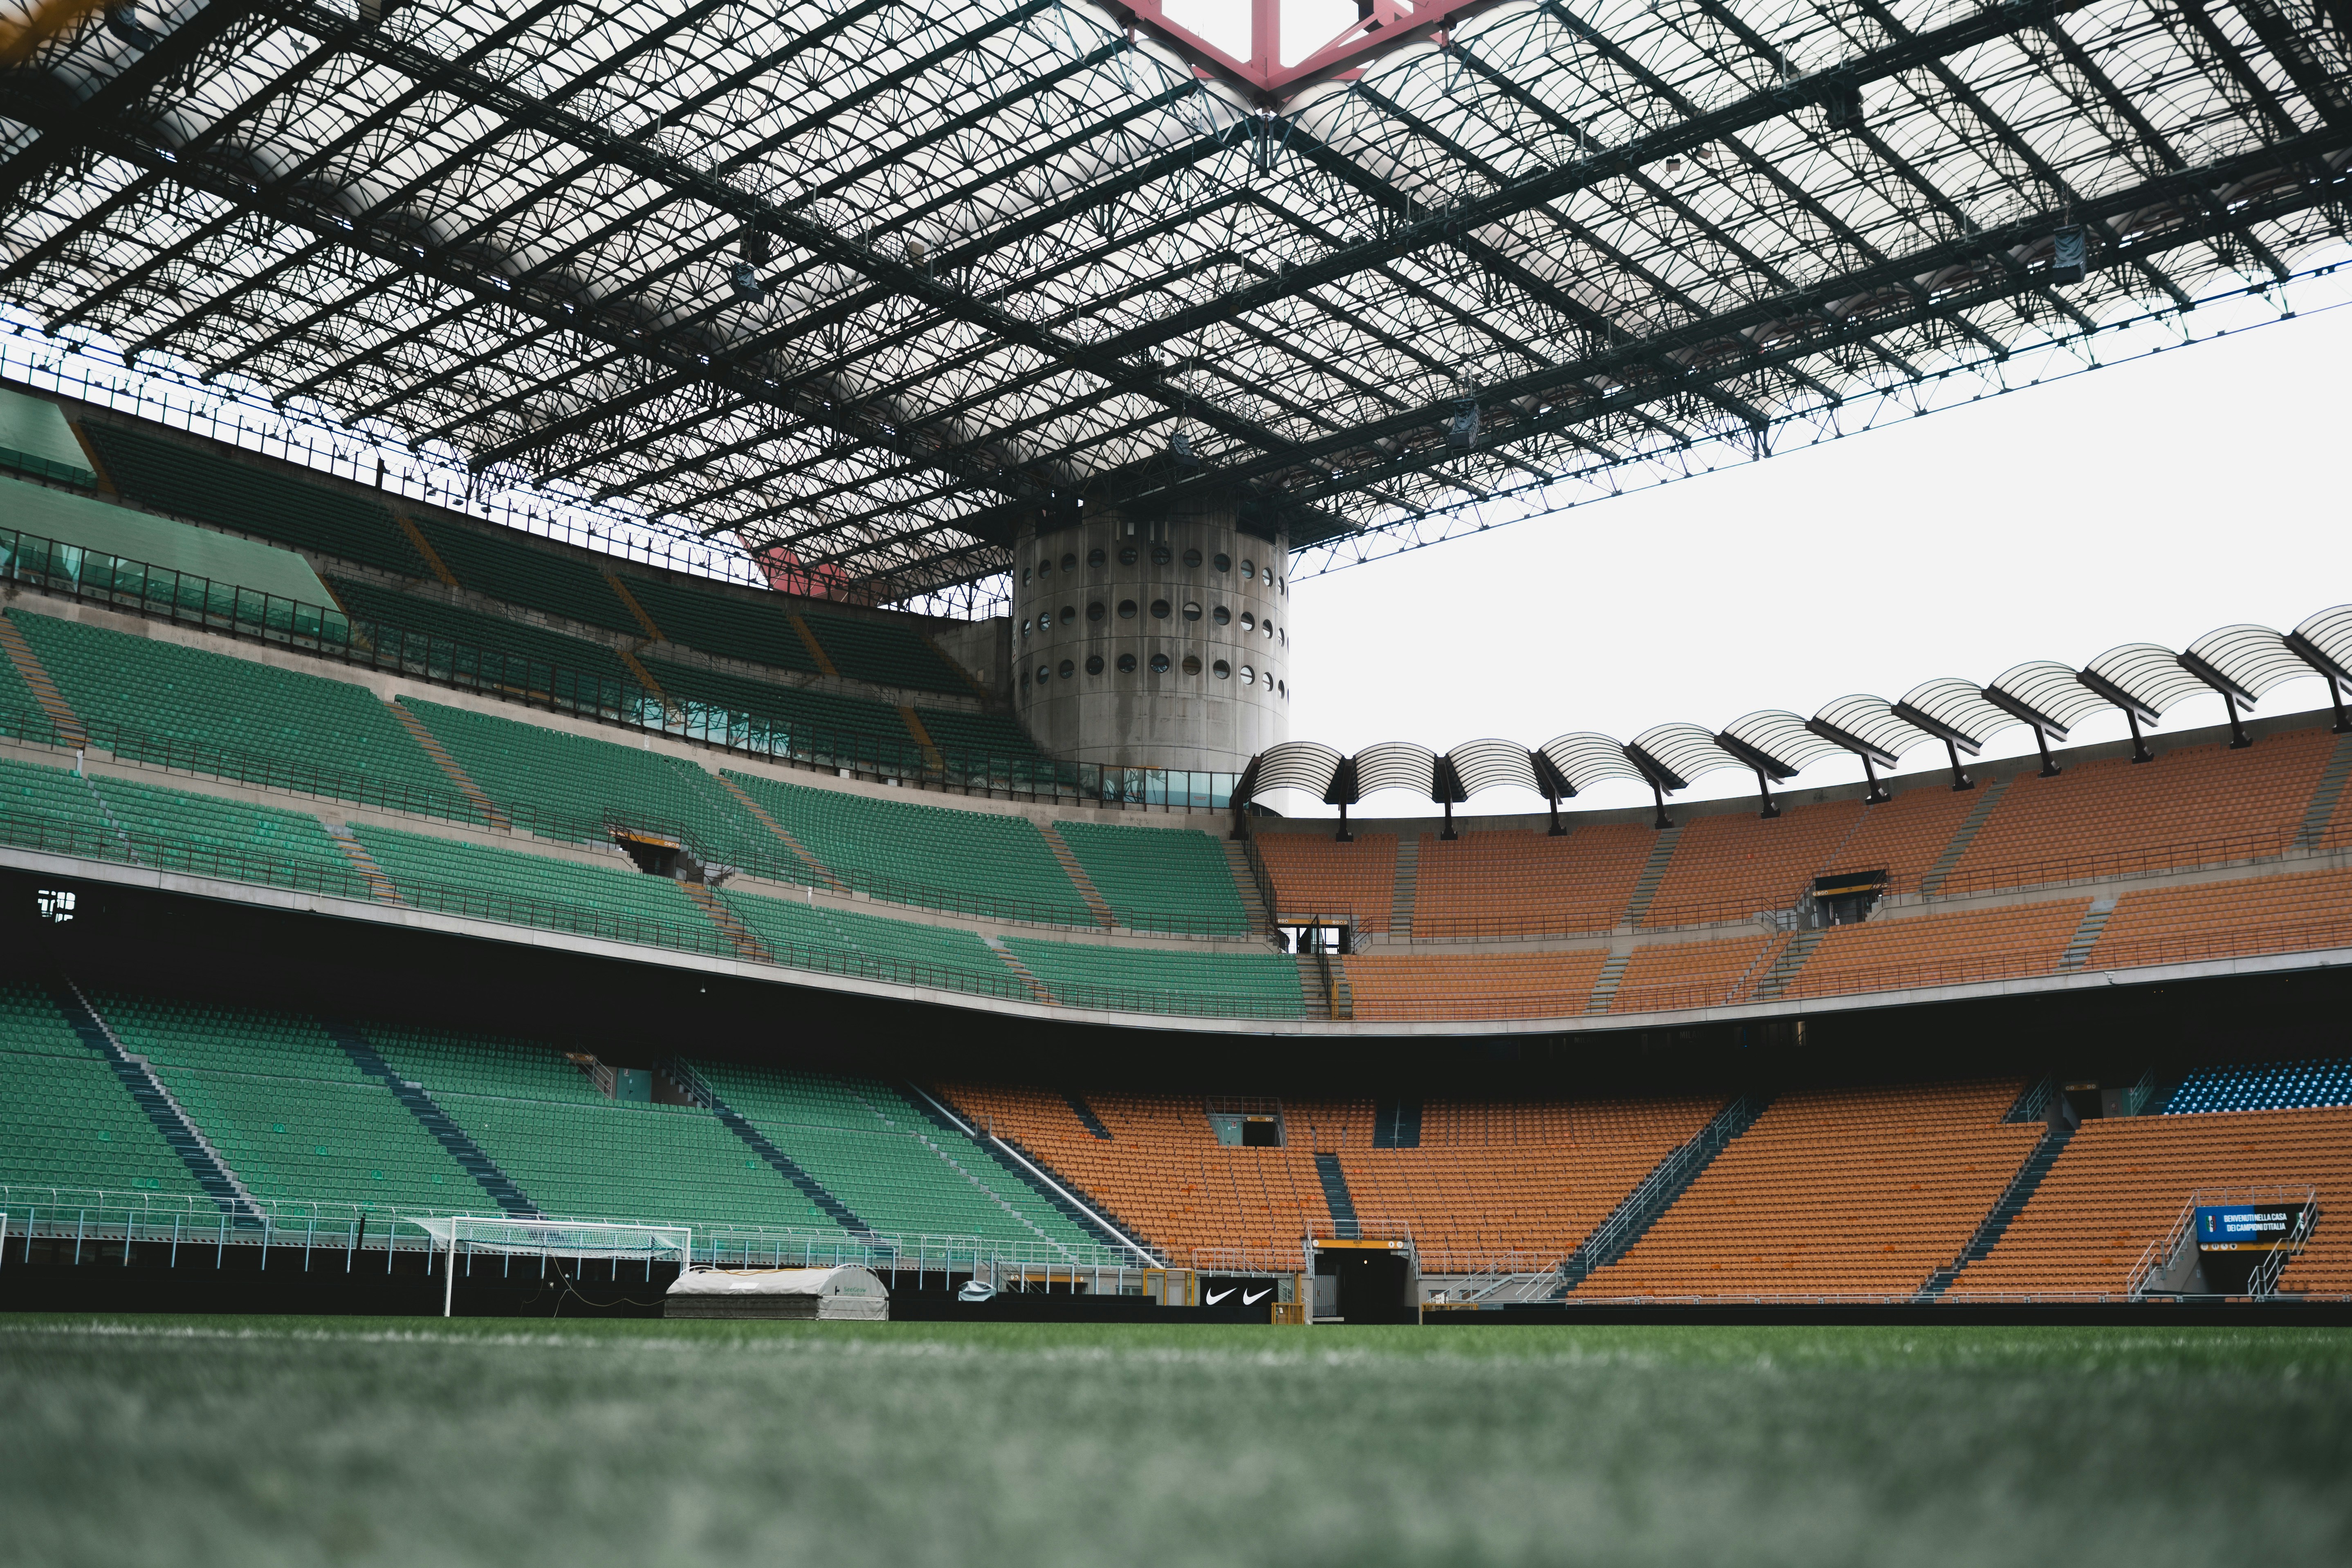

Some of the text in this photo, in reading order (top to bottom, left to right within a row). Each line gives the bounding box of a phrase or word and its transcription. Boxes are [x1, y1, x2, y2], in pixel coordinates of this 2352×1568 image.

[2224, 1214, 2254, 1223] BENVENUTI
[2271, 1213, 2287, 1221] CASA
[2208, 1220, 2215, 1228] 19
[2226, 1223, 2286, 1232] DEI CAMPIONI D'ITALIA
